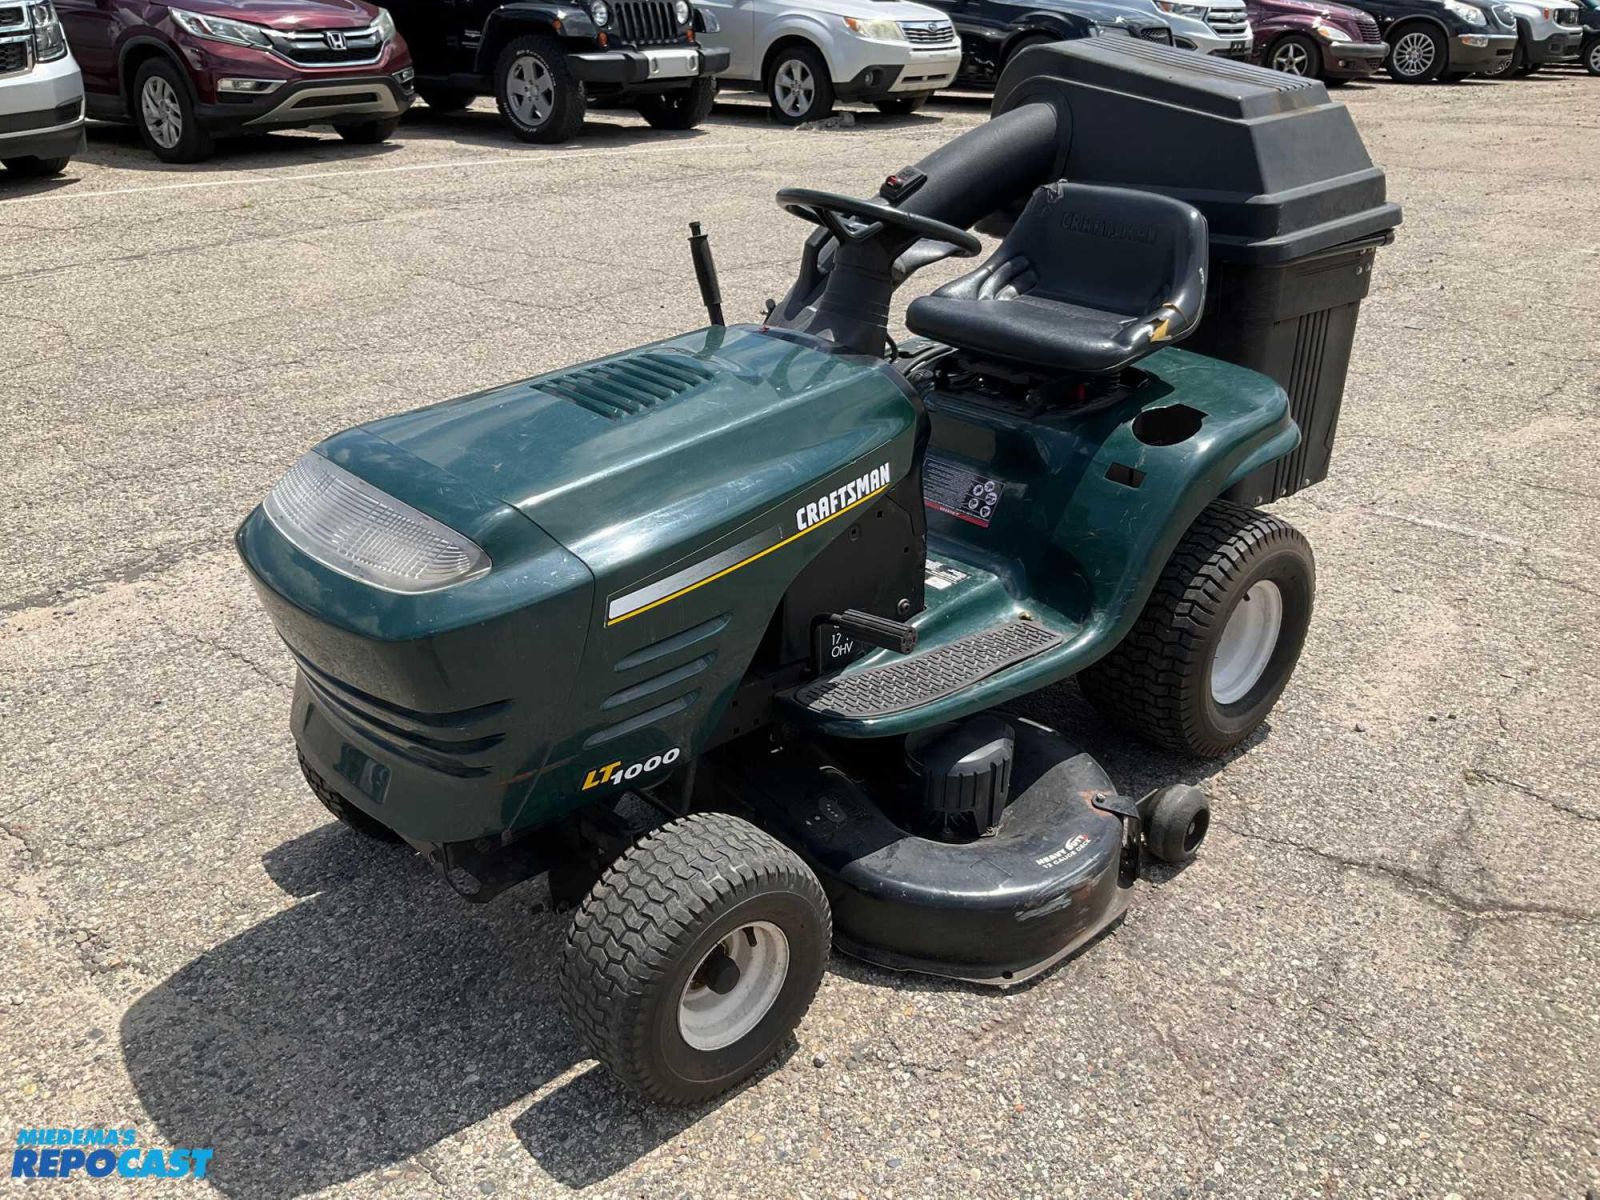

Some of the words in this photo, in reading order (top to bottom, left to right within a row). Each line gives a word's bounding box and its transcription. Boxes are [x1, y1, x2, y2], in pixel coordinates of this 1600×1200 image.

[796, 462, 890, 531] CRAFTSMAN
[831, 640, 854, 658] OHV
[582, 748, 680, 790] LT1000
[1035, 848, 1067, 865] HEAVY
